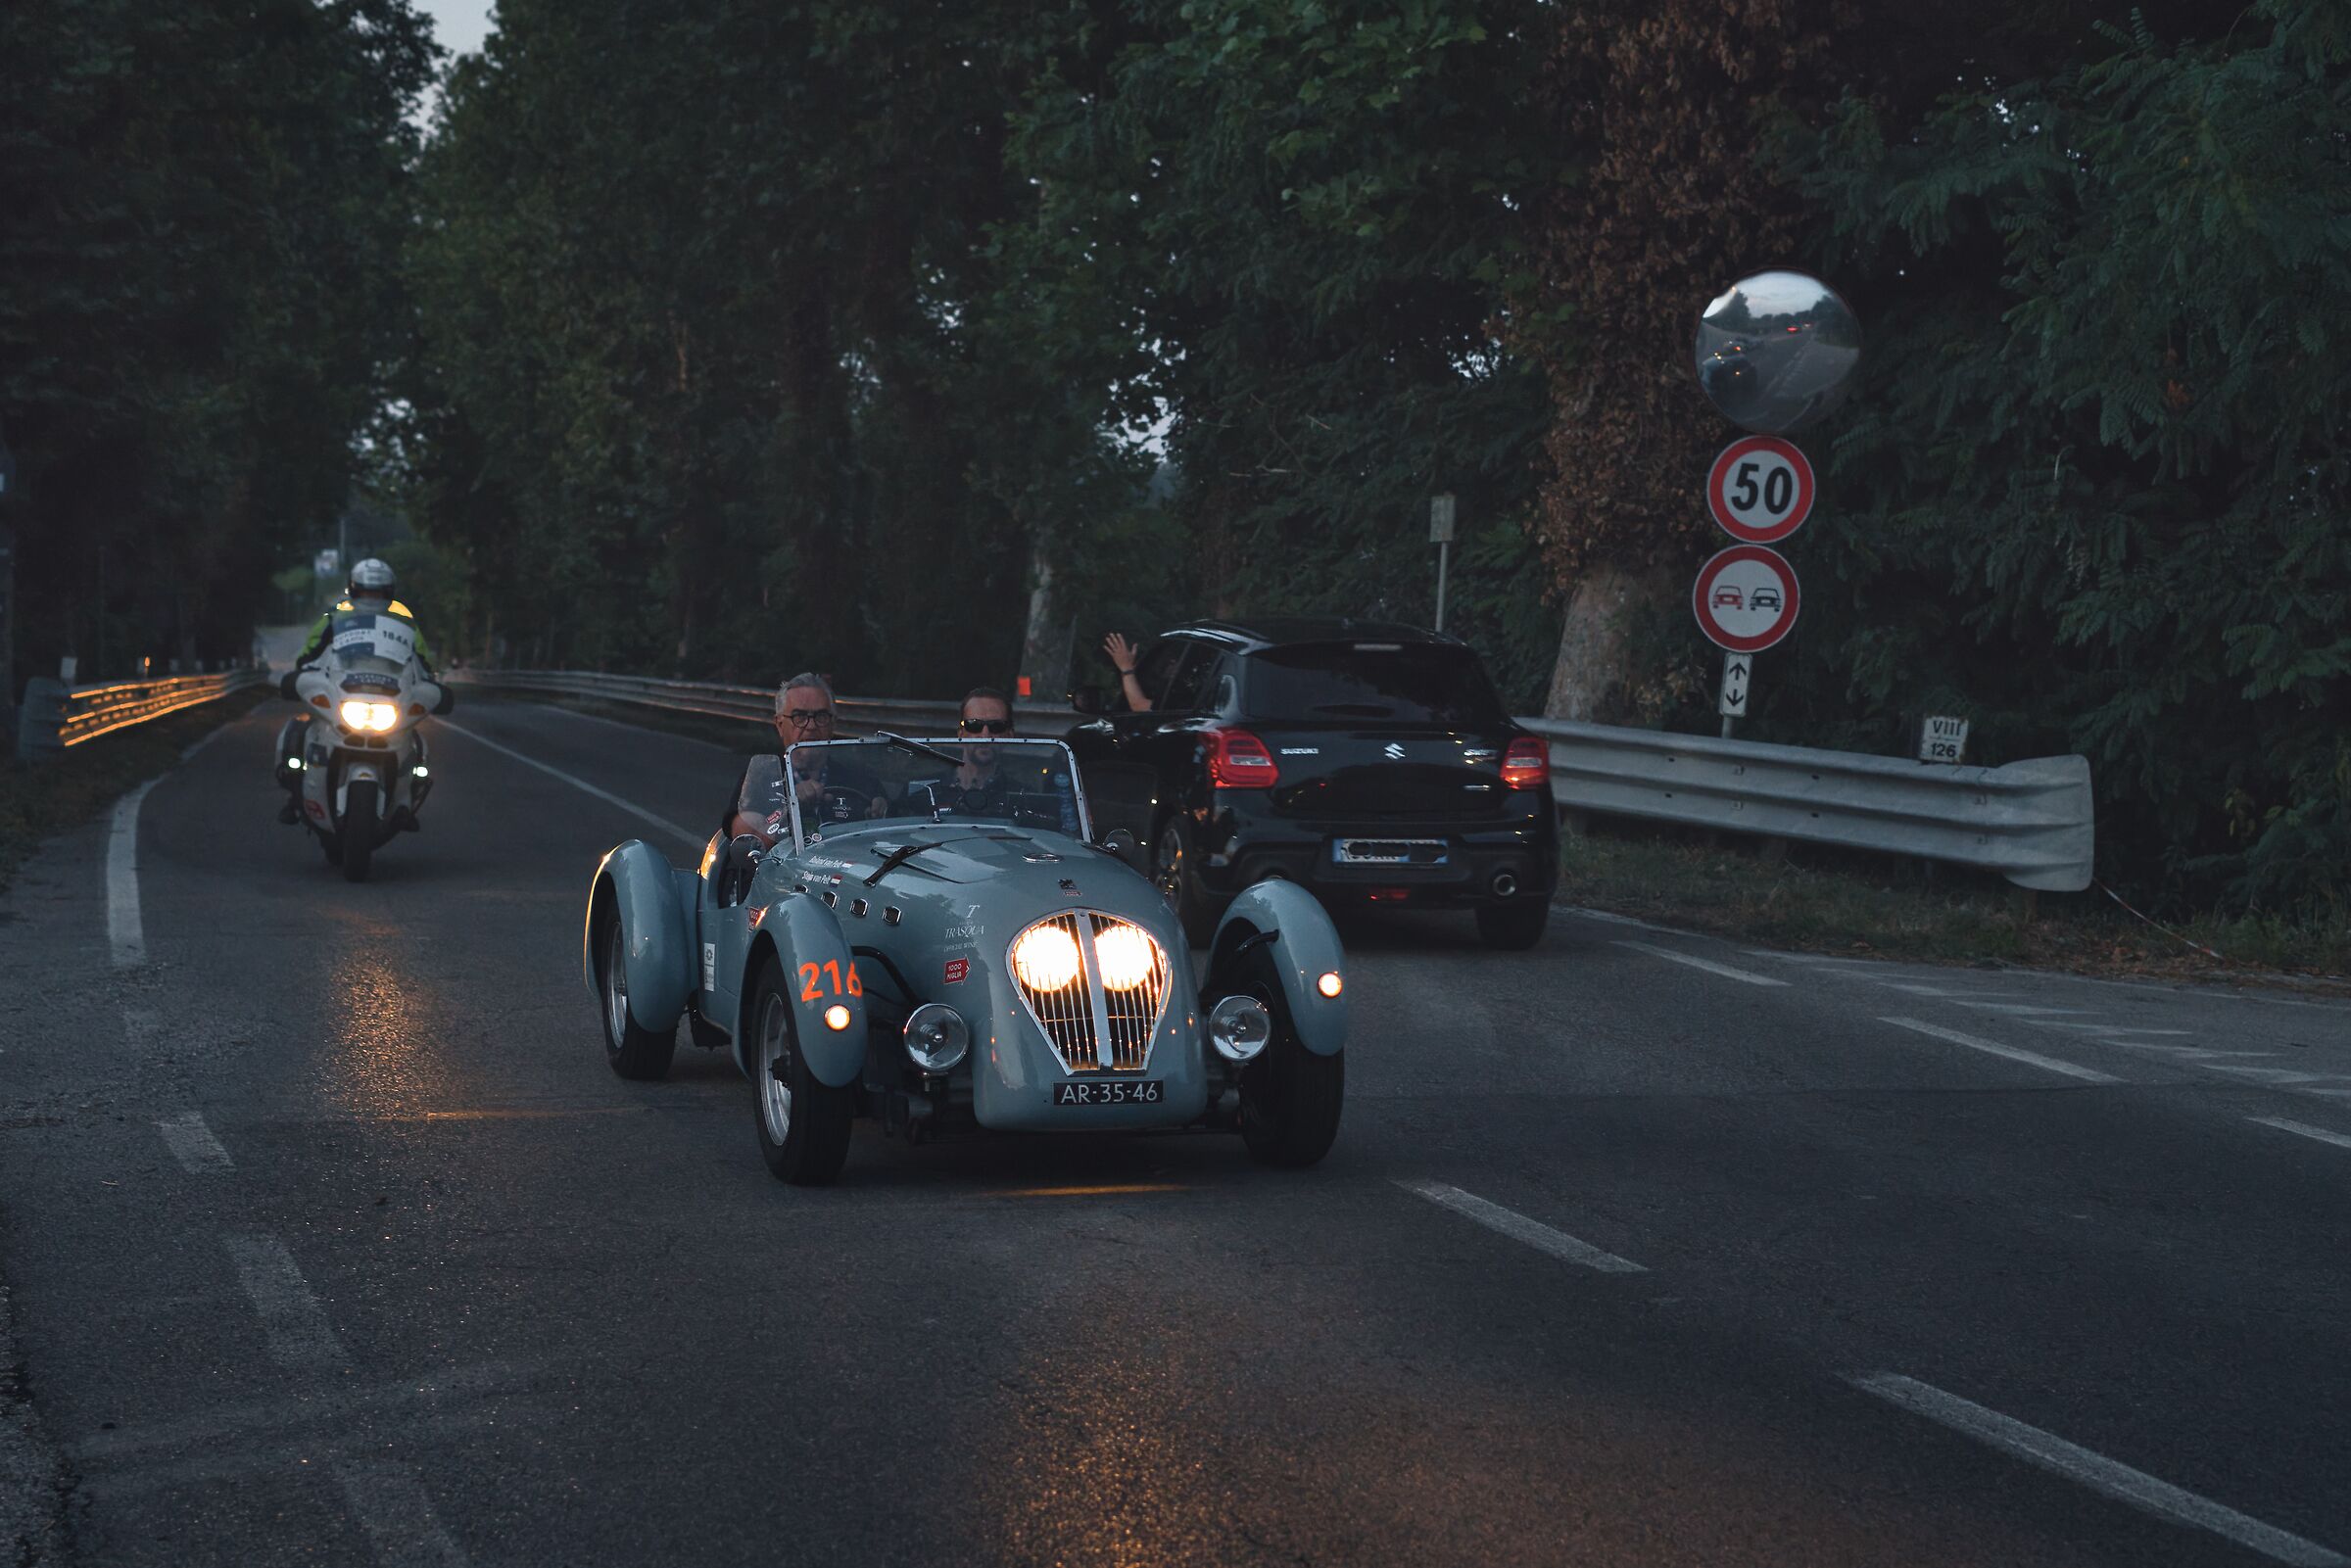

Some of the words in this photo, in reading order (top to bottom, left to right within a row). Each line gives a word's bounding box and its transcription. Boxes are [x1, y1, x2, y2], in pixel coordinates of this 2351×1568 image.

[1731, 462, 1793, 515] 50
[1933, 720, 1961, 736] VIII
[1931, 742, 1957, 758] 126
[799, 959, 862, 1002] 216
[947, 971, 962, 979] MIGLIA
[1061, 1082, 1157, 1104] AR-35-46
